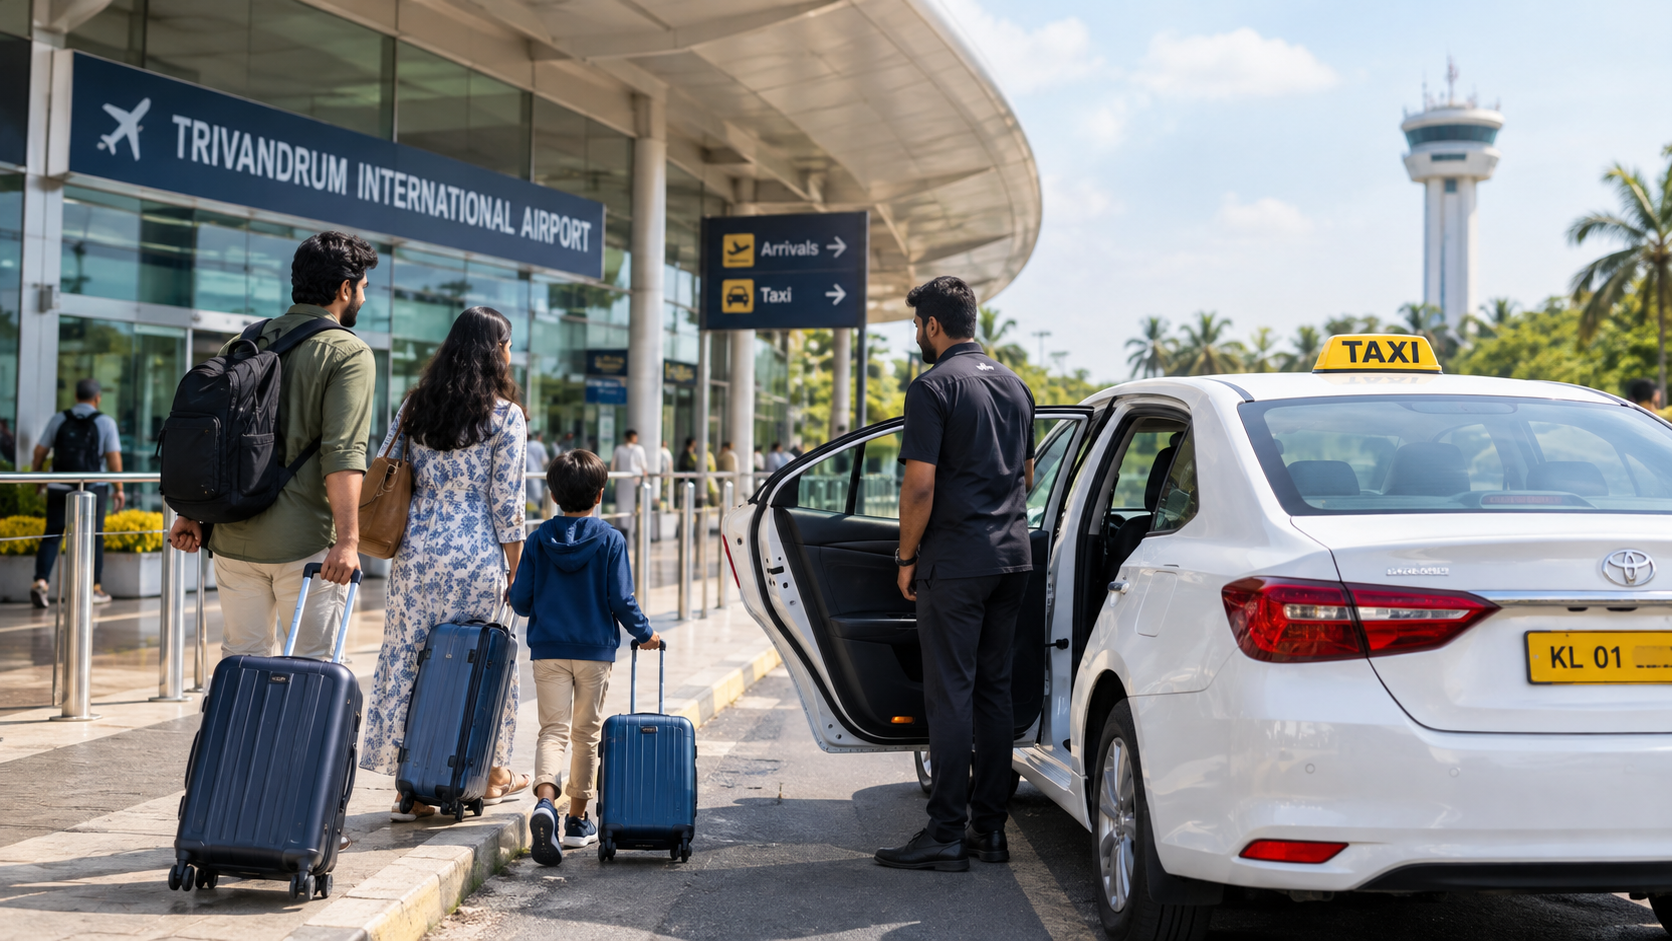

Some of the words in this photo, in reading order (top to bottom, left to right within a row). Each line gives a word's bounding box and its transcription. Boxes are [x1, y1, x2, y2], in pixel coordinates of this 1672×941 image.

[172, 114, 348, 197] TRIVANDRUM
[357, 162, 515, 235] INTERNATIONAL
[520, 206, 591, 253] AIRPORT
[760, 240, 819, 257] Arrivals
[760, 286, 792, 303] Taxi
[1341, 340, 1420, 363] TAXI
[1550, 646, 1584, 669] KL
[1593, 645, 1622, 669] 01
